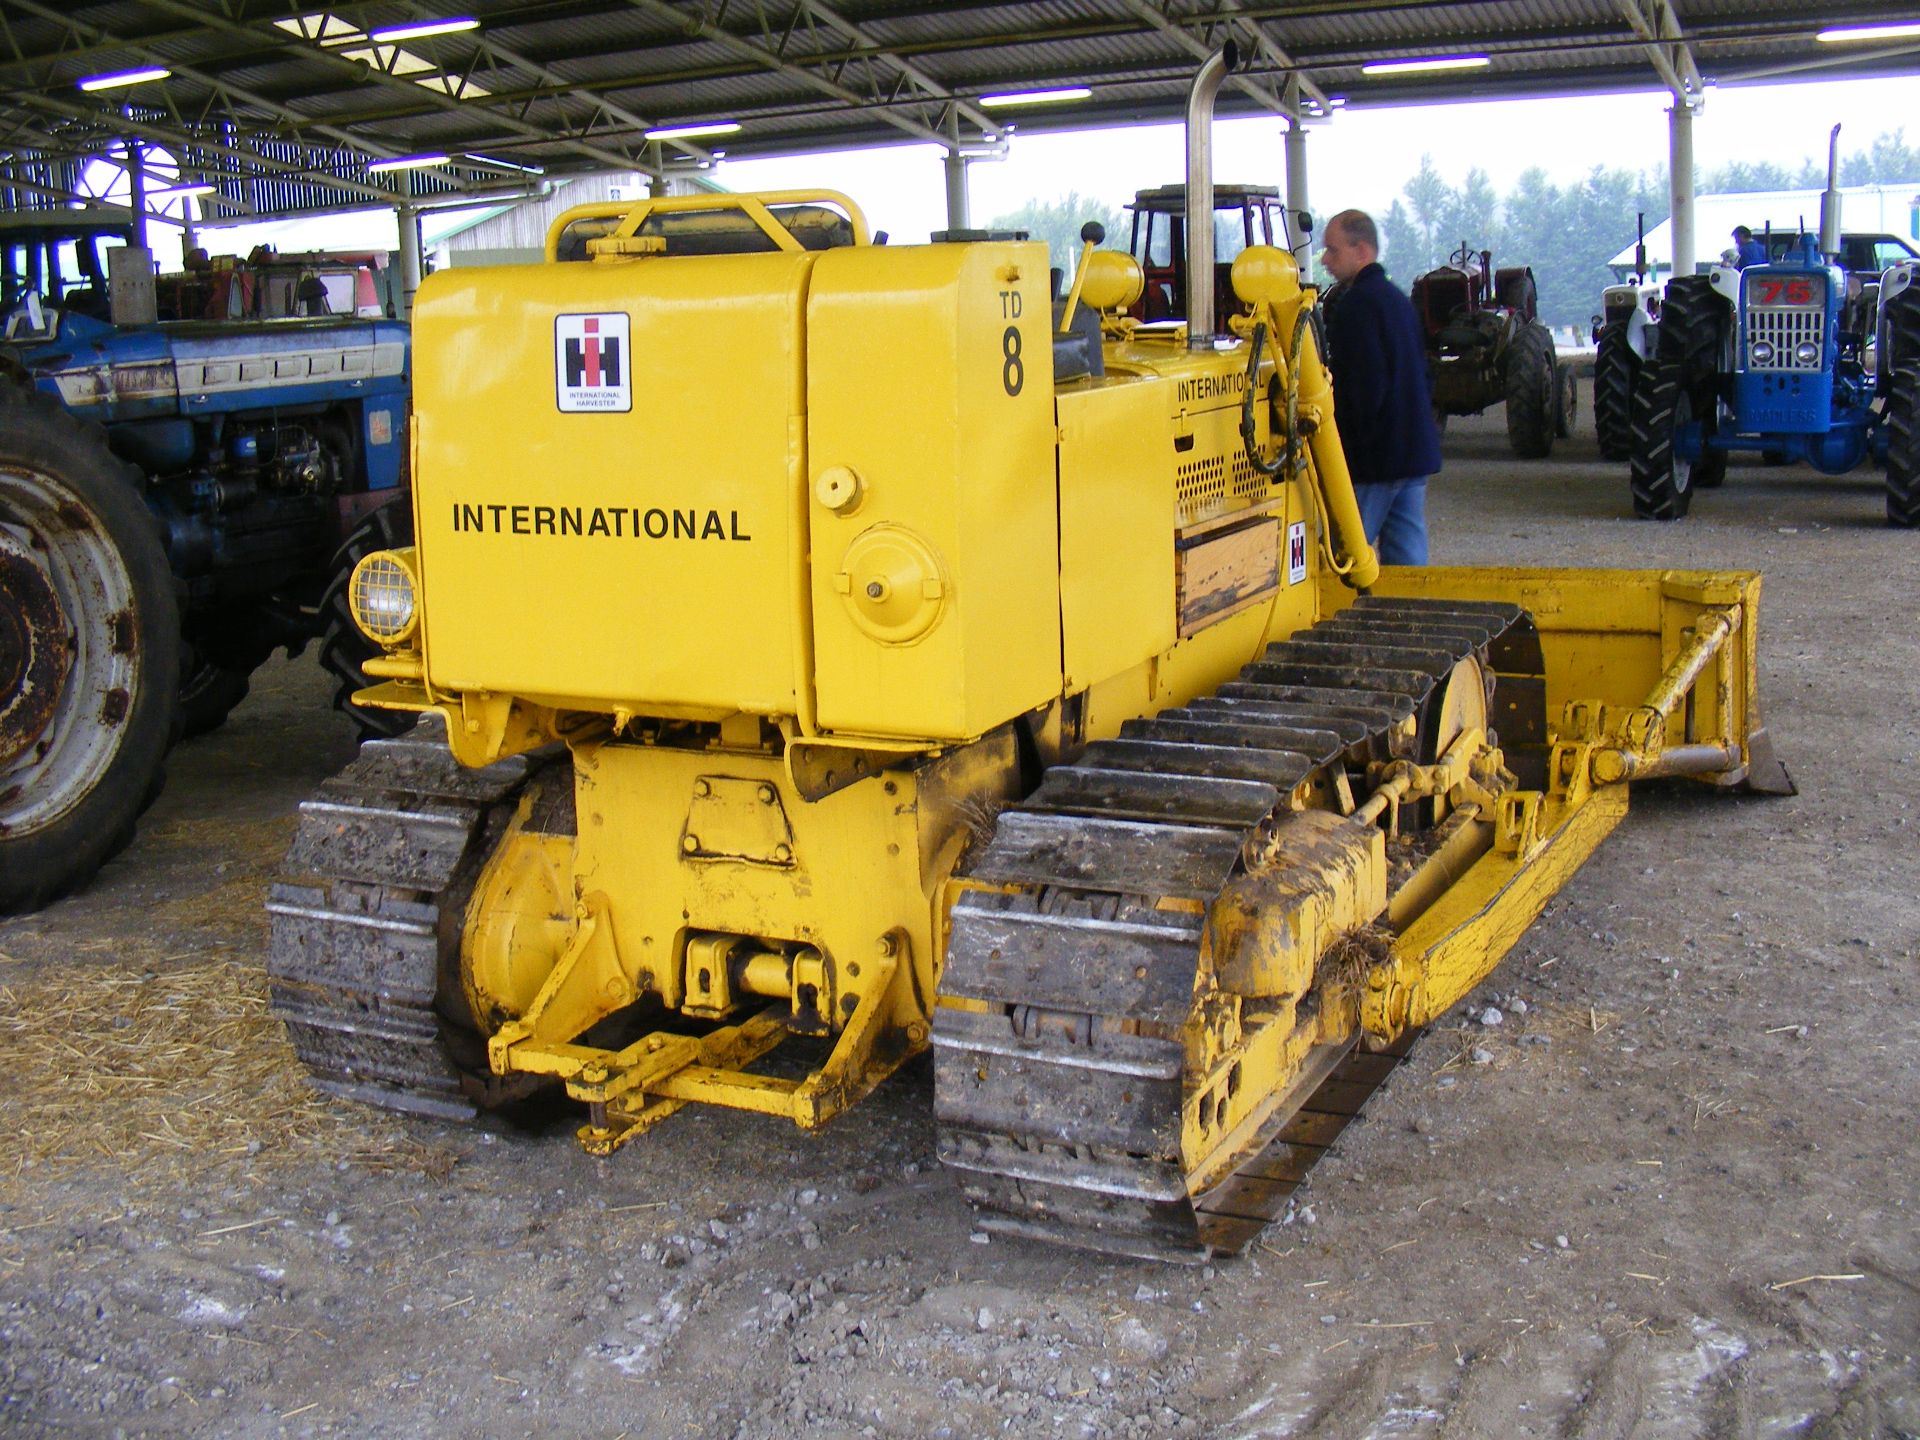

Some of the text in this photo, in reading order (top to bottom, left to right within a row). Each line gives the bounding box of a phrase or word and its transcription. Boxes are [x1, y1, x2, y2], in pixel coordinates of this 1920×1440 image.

[999, 291, 1021, 319] TD
[1759, 280, 1811, 304] 75
[1003, 326, 1024, 397] 8
[569, 391, 621, 399] INTERNATIONAL
[1178, 370, 1265, 402] INTERNATIOL
[576, 399, 616, 407] HARVESTER
[453, 503, 751, 541] INTERNATIONAL
